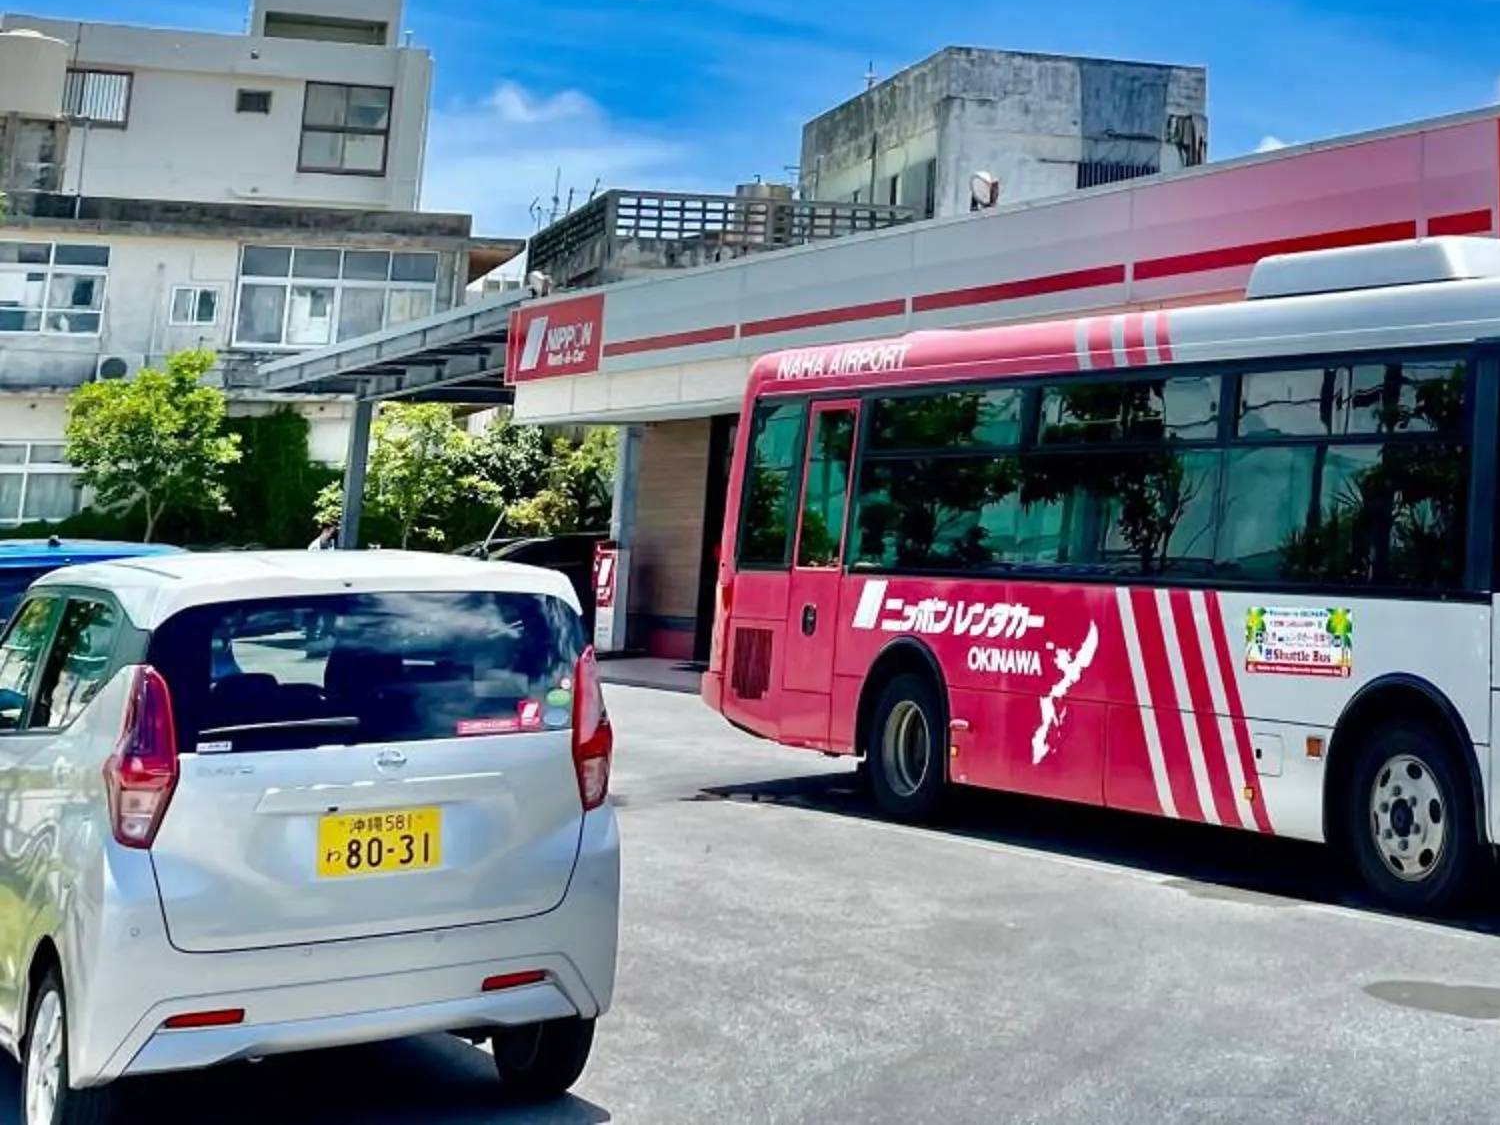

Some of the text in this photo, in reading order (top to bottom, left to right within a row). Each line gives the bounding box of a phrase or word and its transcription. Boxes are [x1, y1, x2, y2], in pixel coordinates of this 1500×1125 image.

[777, 342, 913, 381] NAHA AIRPORT
[880, 596, 1045, 639] ニッポンレンタカー
[967, 645, 1043, 676] OKINAWA
[1273, 648, 1332, 664] Shuttle Bus
[345, 831, 430, 869] 80-31
